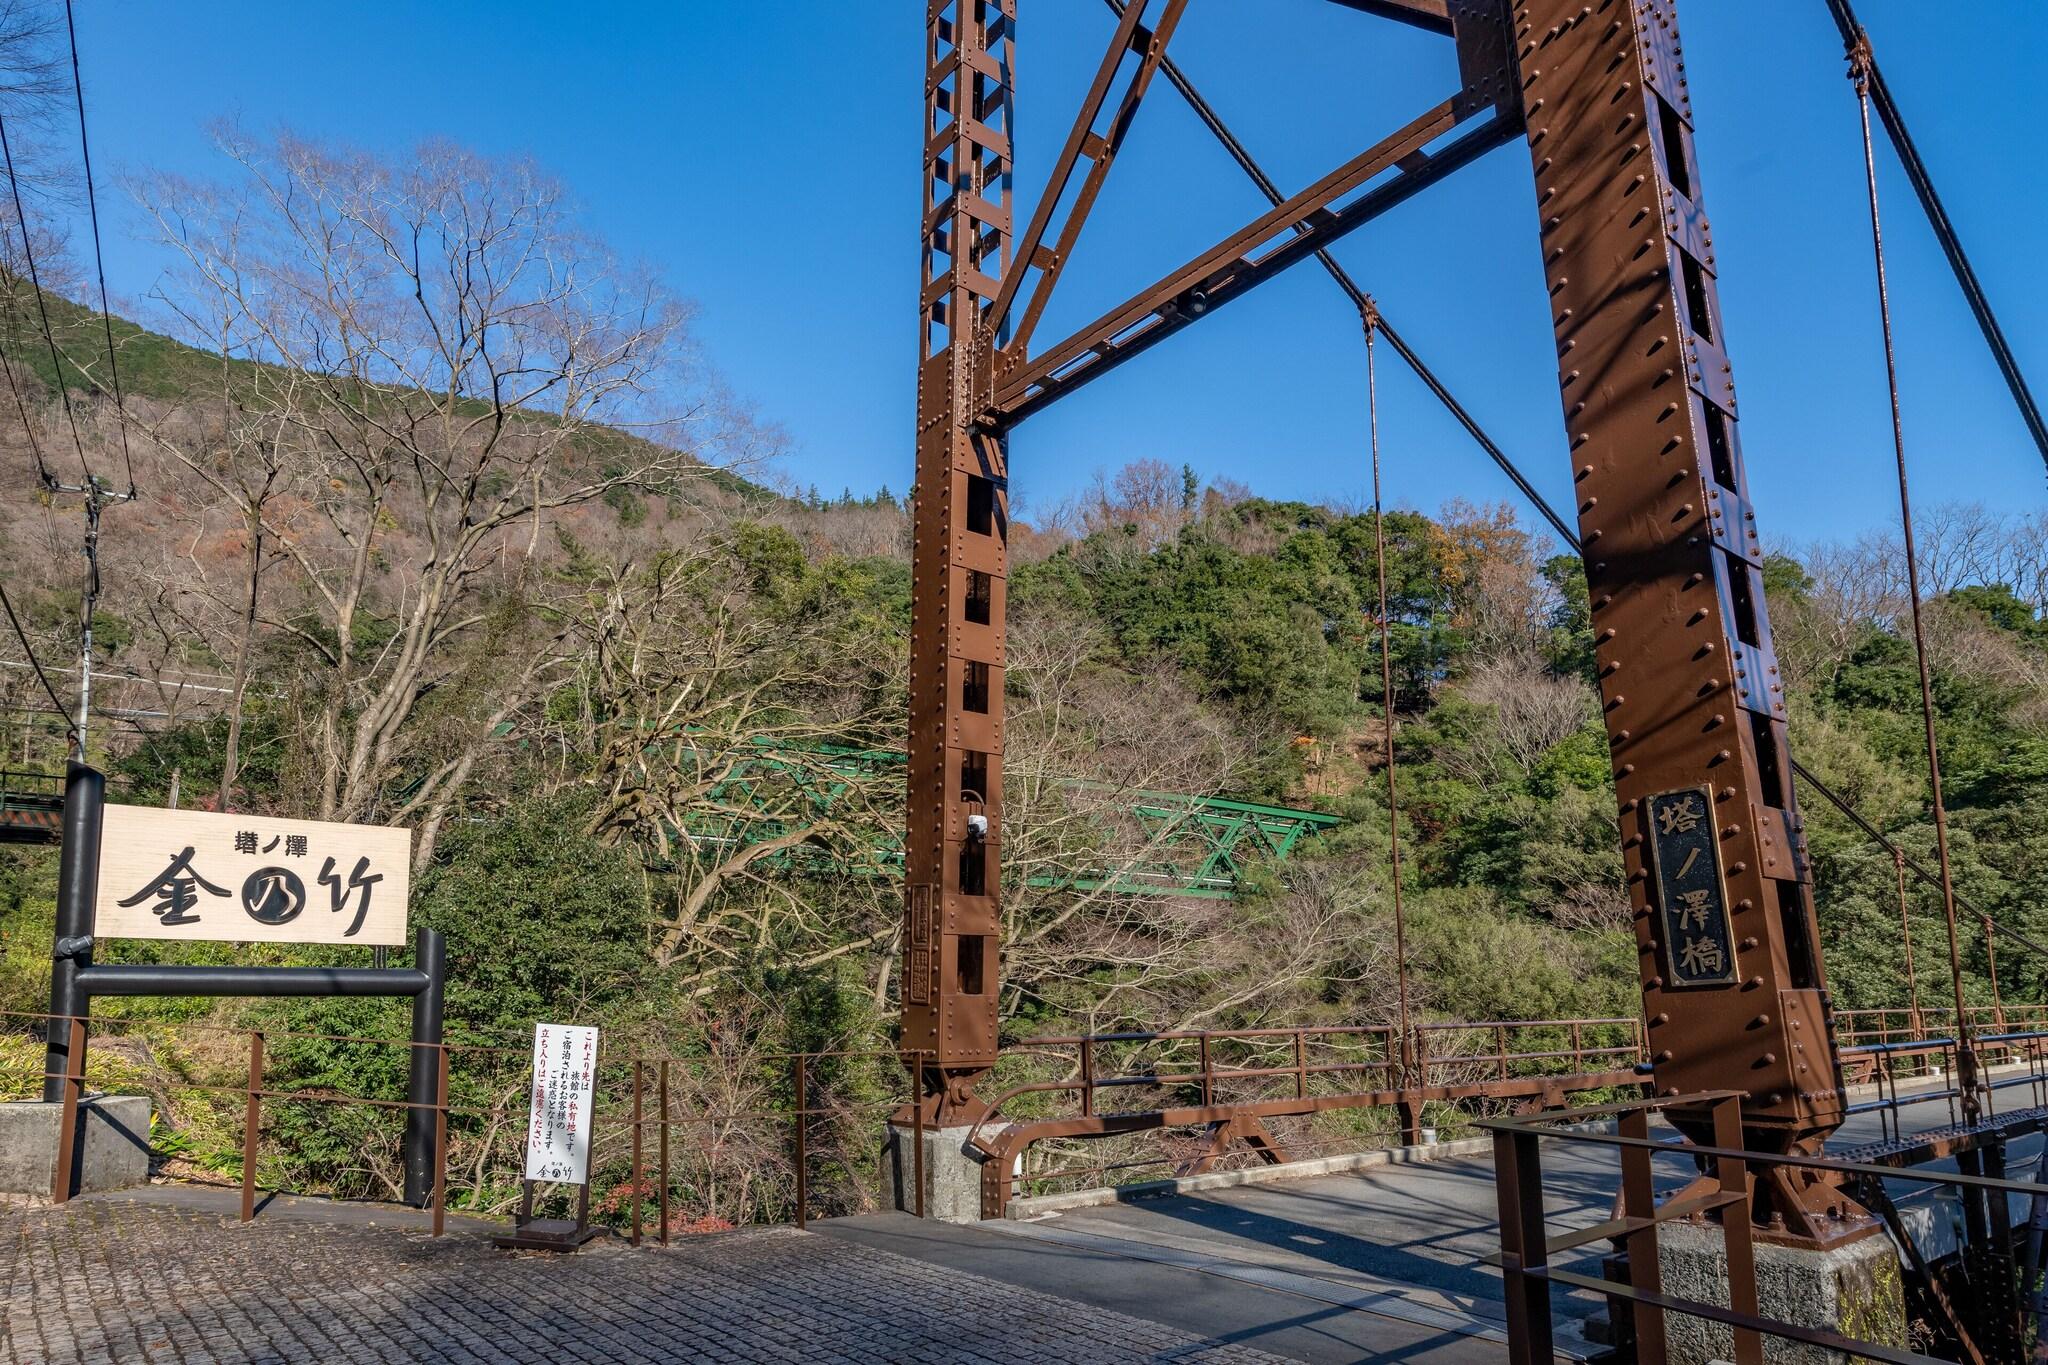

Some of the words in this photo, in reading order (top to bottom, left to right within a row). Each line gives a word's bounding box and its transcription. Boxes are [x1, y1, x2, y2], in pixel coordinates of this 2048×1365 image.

[234, 831, 308, 858] 塔ノ澤
[1659, 796, 1722, 975] 塔ノ澤橋
[556, 1030, 573, 1130] ご宿泊されるお客様の
[580, 1031, 593, 1091] これより先は
